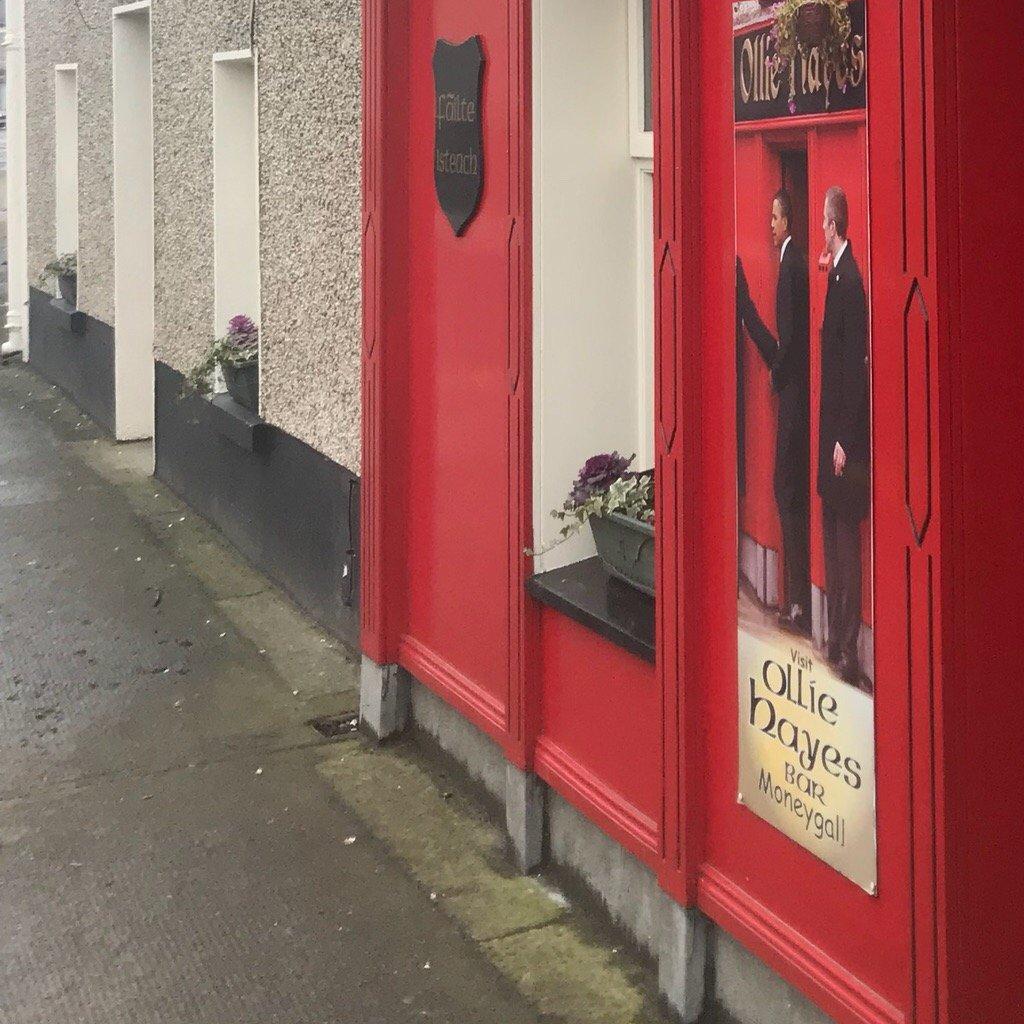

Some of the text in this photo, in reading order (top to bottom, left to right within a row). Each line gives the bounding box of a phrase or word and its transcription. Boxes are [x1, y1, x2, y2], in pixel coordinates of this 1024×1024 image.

[790, 648, 814, 674] Visit
[750, 677, 862, 790] hayes
[758, 767, 846, 847] Moneygall
